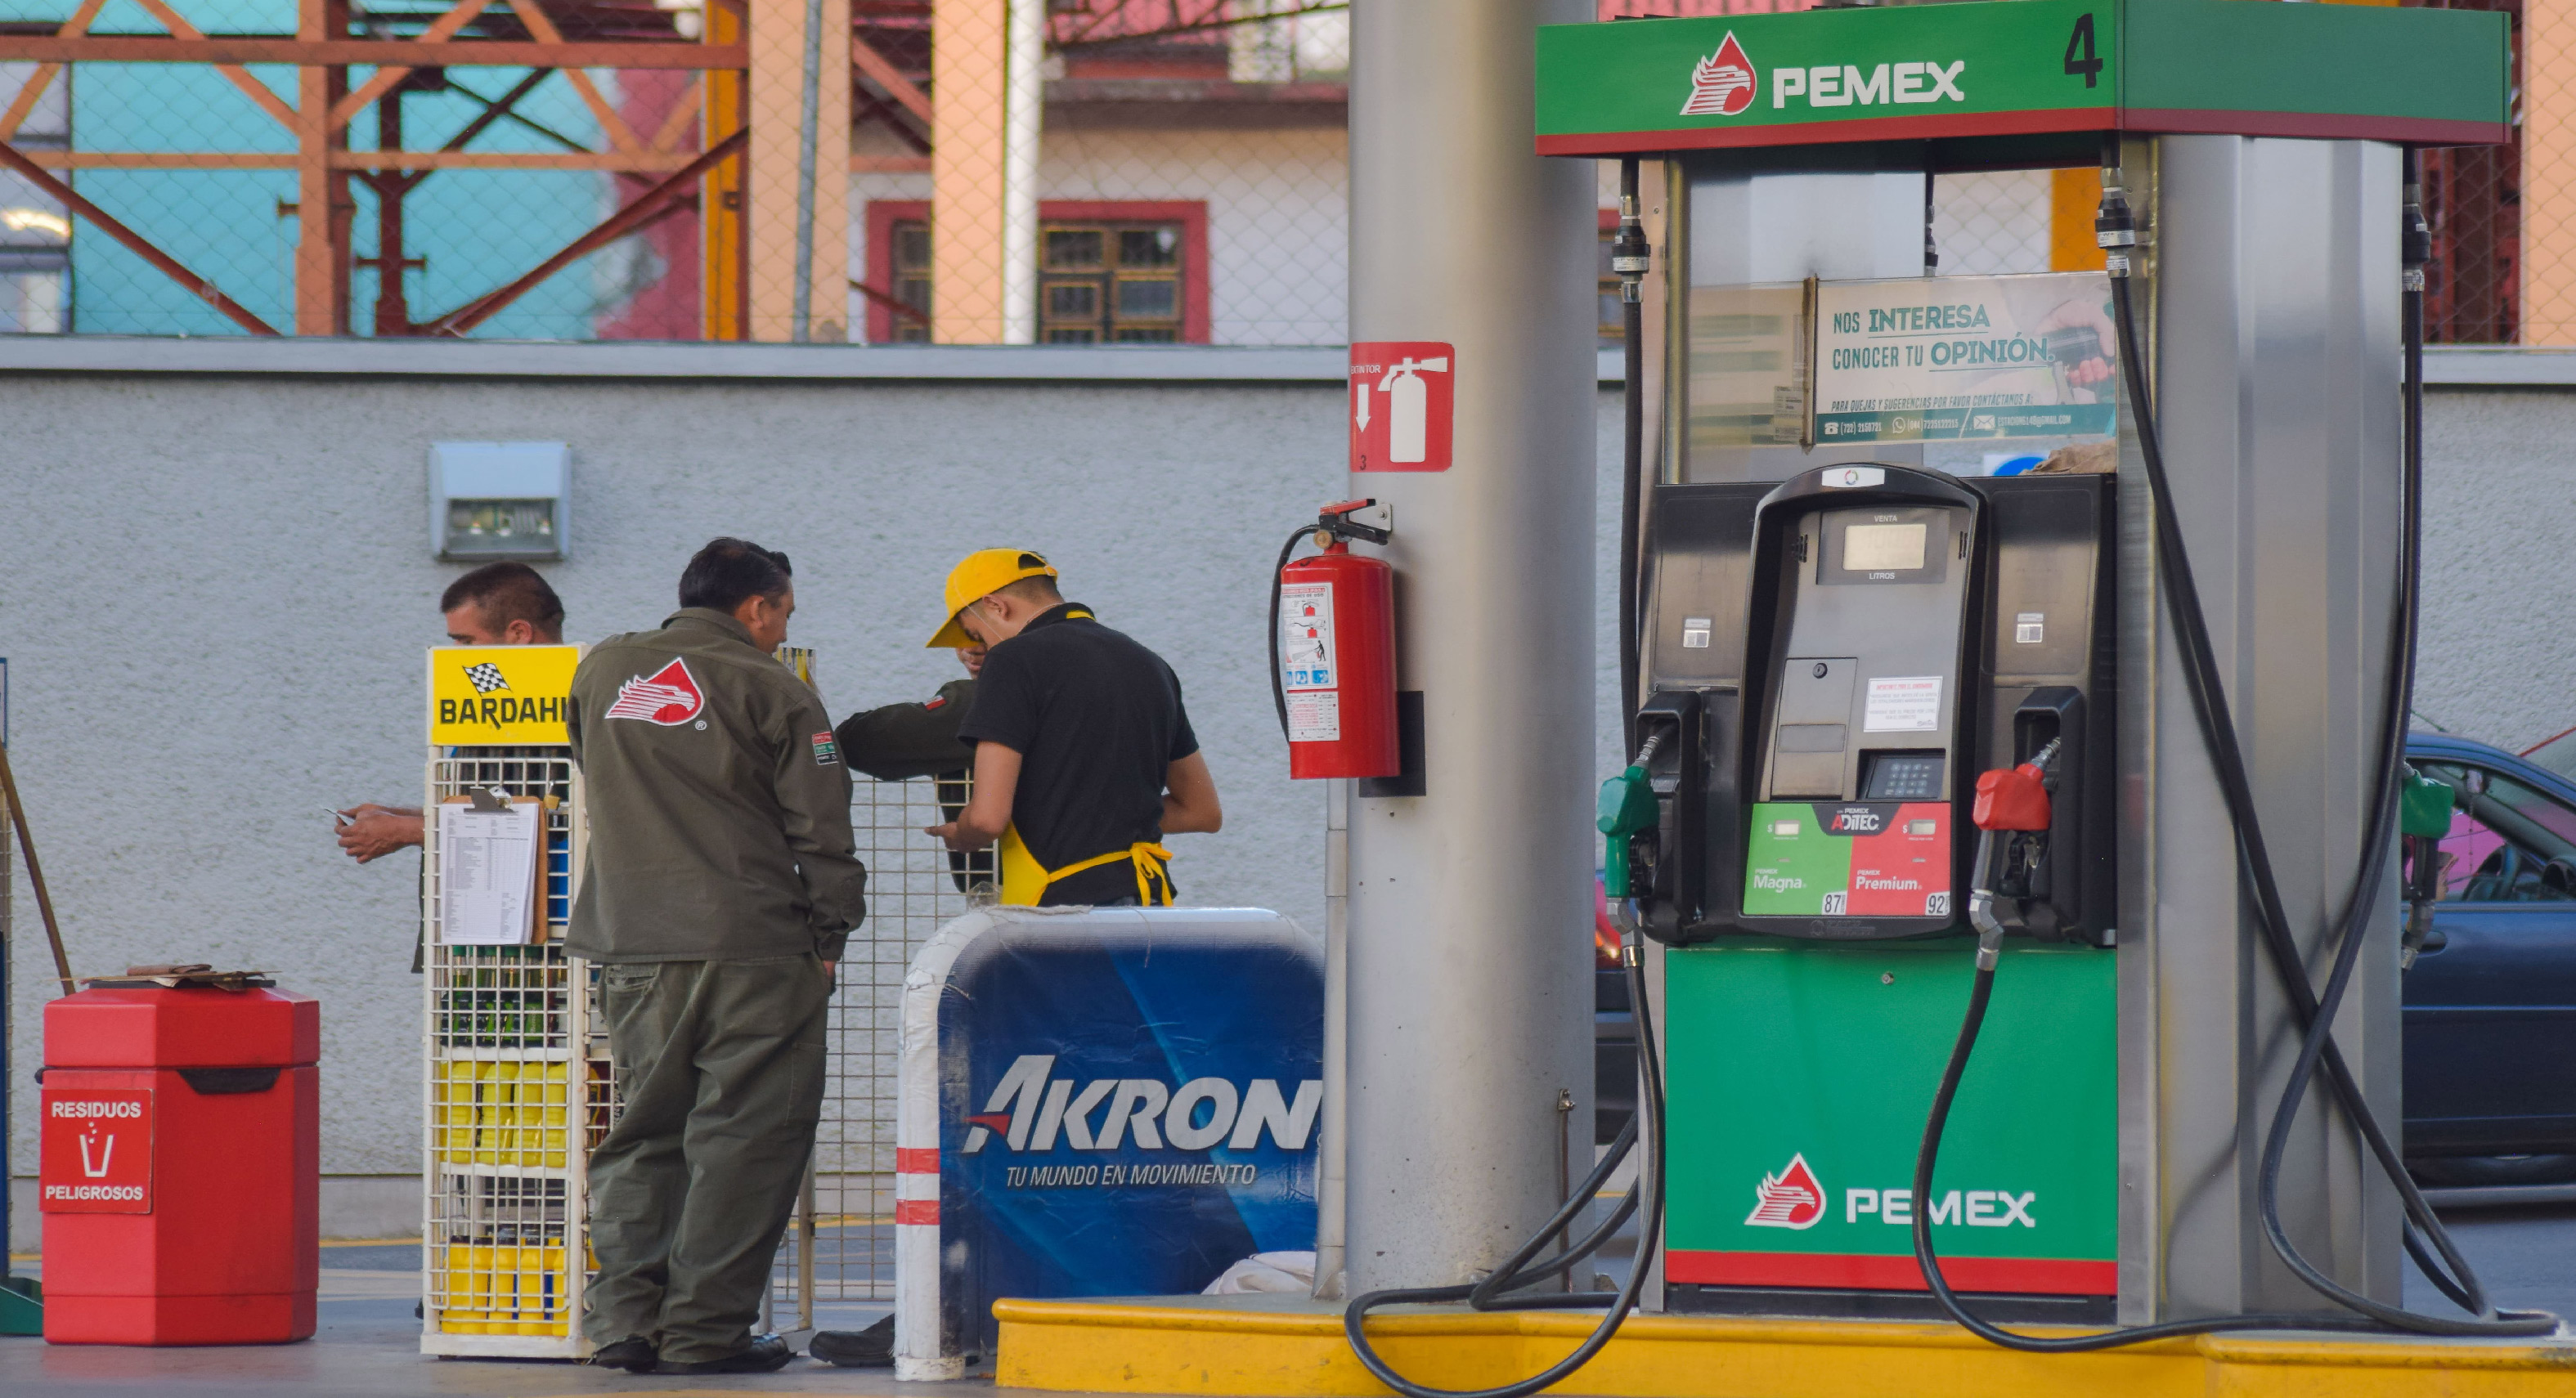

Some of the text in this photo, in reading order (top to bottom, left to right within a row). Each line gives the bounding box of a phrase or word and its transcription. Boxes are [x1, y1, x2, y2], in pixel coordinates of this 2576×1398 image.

[2063, 12, 2104, 89] 4
[1773, 60, 1965, 109] PEMEX
[1833, 303, 1990, 334] NOS INTERESA
[1832, 332, 2055, 370] CONOCER TU OPINIÓN.
[1831, 401, 1849, 412] PARA
[1851, 399, 1876, 412] QUEJAS
[1878, 399, 1883, 410] Y
[1884, 397, 1931, 410] SUGERENCIAS
[1932, 396, 1947, 408] POR
[1949, 395, 1971, 407] FAVOR
[1753, 875, 1802, 894] Magna
[1856, 876, 1918, 890] Premium
[1824, 894, 1841, 914] 87
[1928, 895, 1945, 914] 92
[52, 1101, 141, 1118] RESIDUOS
[961, 1055, 1323, 1154] AKRON
[1007, 1163, 1256, 1187] TU MUNDO EN MOVIMIENTO
[45, 1185, 143, 1200] PELIGROSOS
[1846, 1188, 2036, 1228] PEMEX
